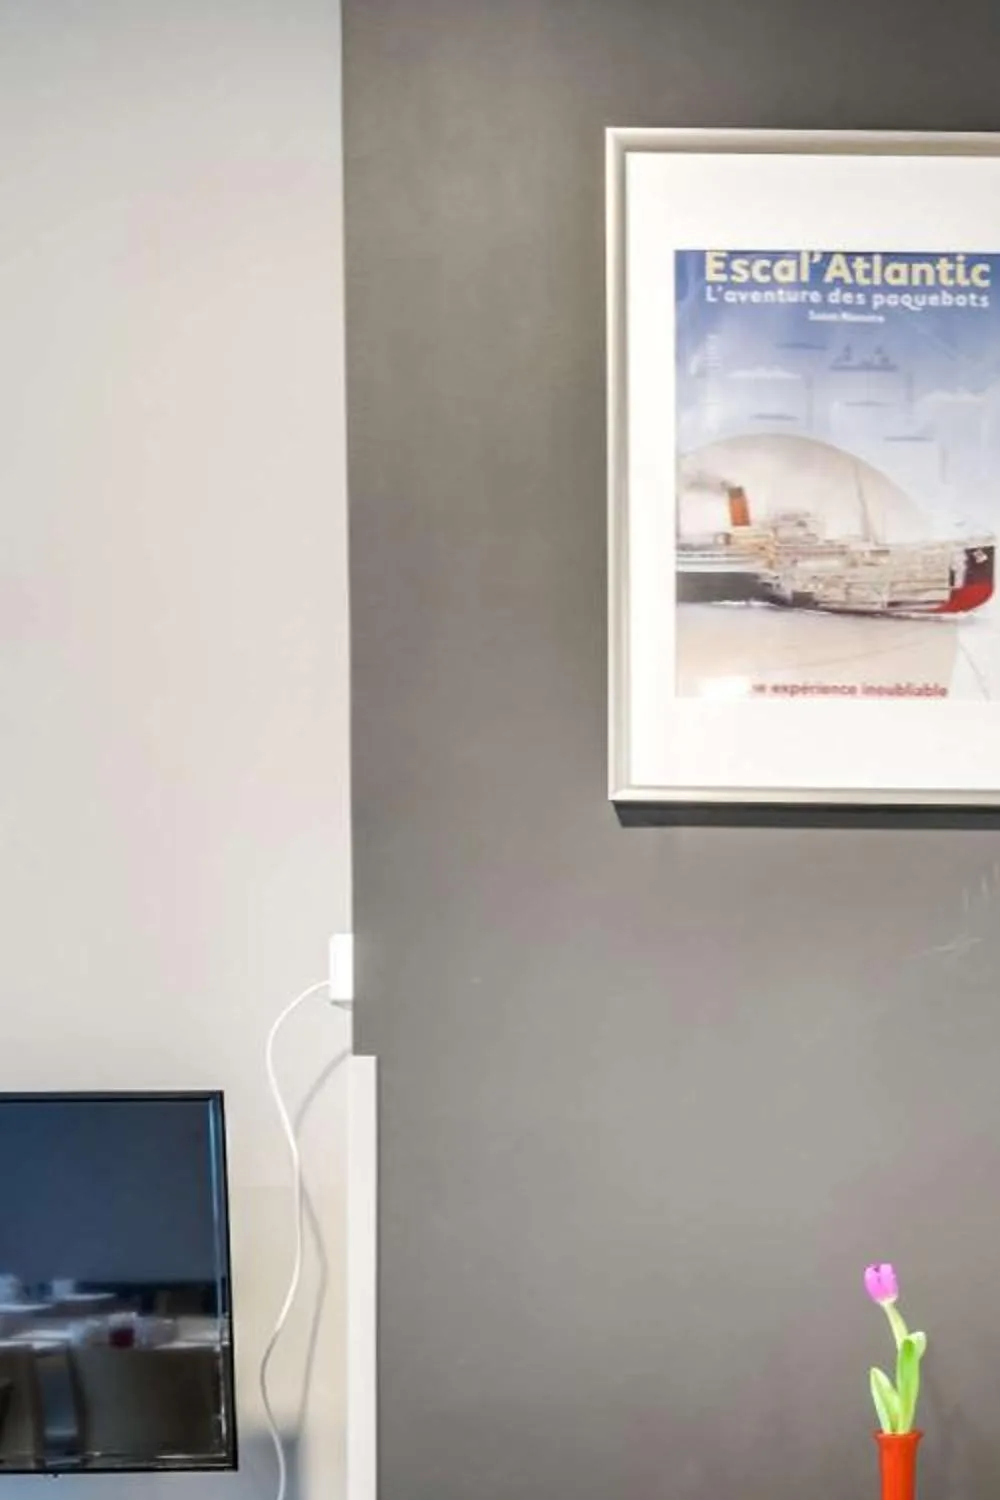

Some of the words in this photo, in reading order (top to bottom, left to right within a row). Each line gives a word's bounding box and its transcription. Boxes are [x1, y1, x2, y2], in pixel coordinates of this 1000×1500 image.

[704, 251, 991, 287] Escal'Atlantic
[705, 286, 822, 304] L'aventure
[826, 287, 866, 305] des
[872, 290, 990, 311] paquebots
[862, 682, 948, 698] inoubliable
